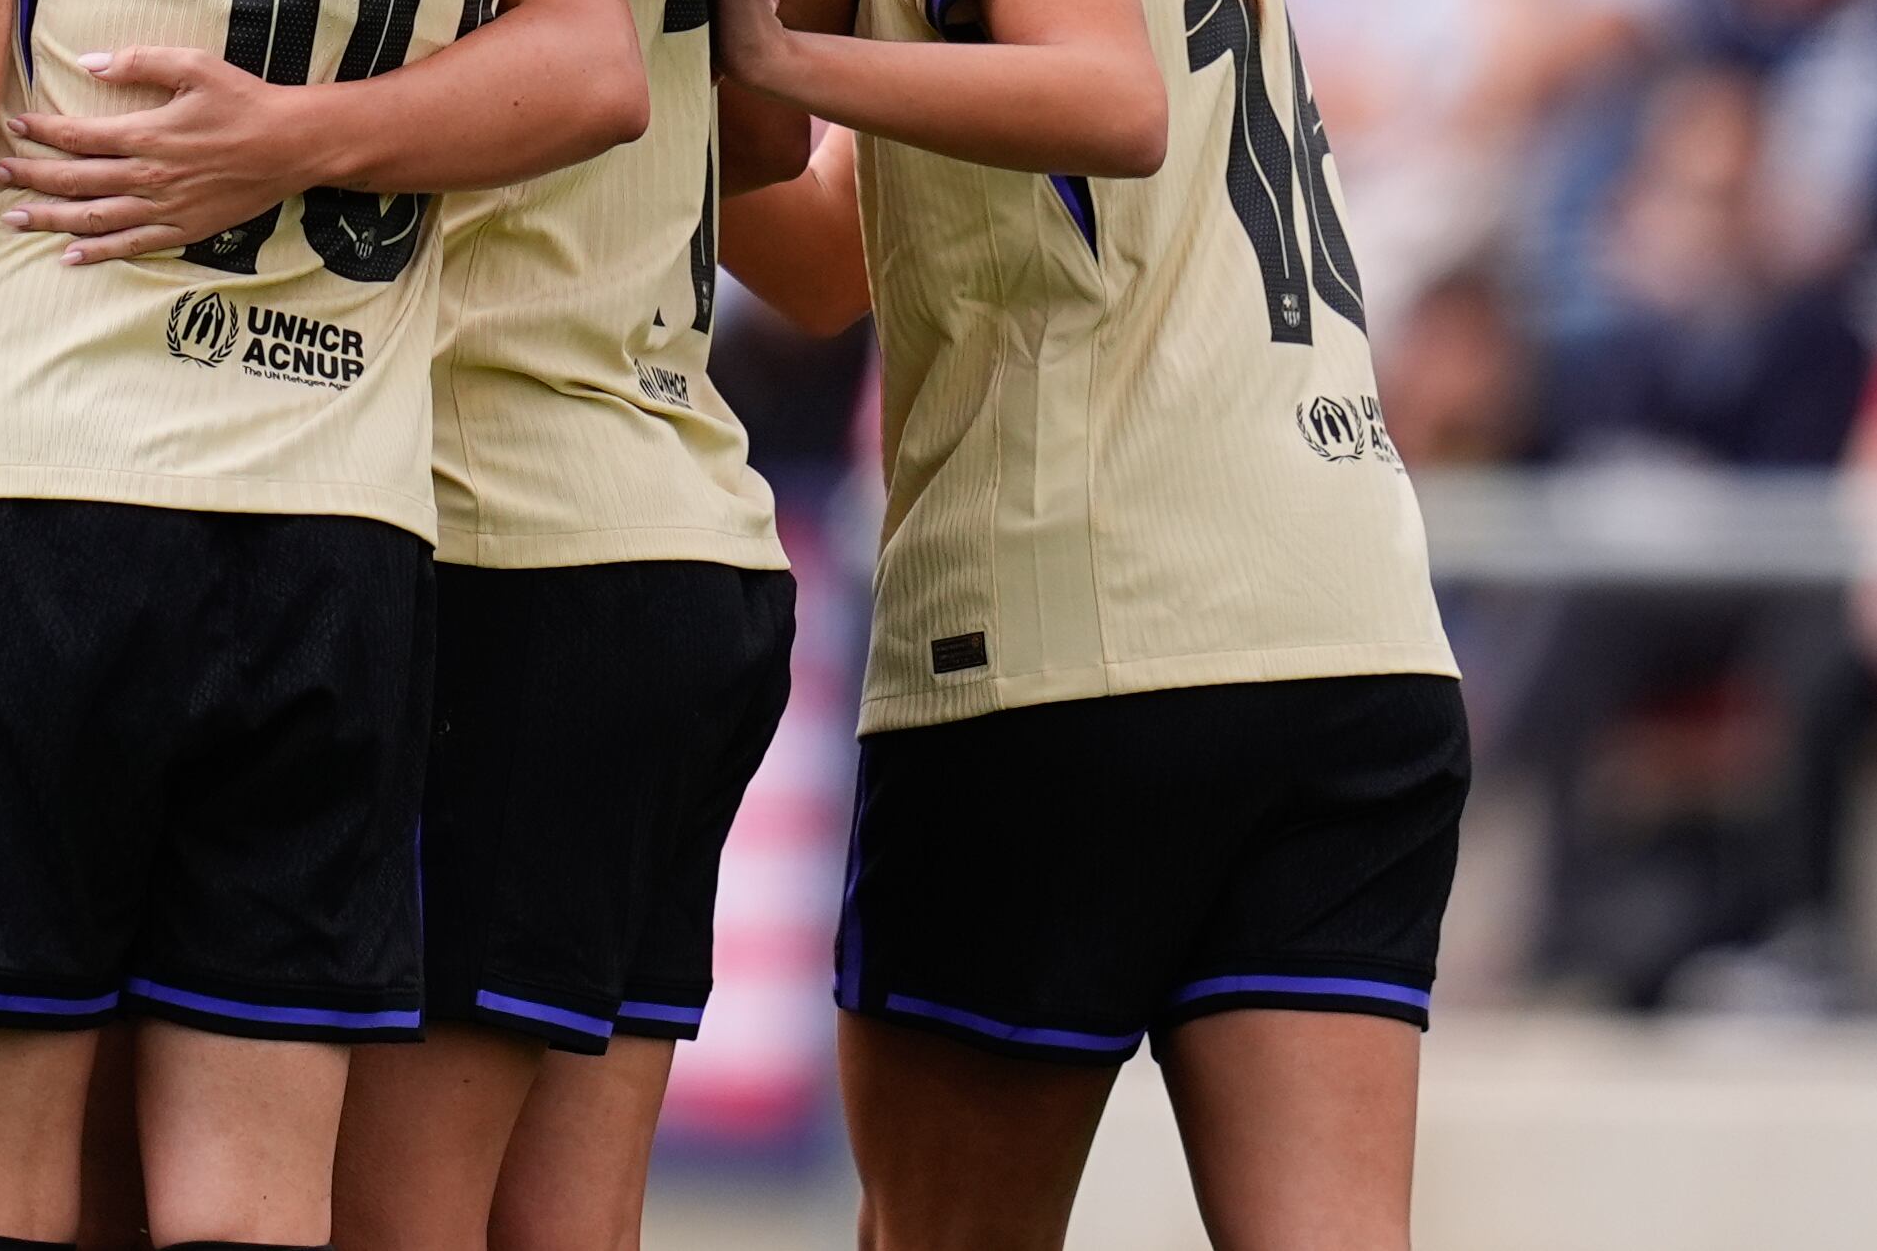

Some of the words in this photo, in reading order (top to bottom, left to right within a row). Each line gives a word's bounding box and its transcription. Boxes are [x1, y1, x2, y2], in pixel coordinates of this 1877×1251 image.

[248, 305, 364, 359] UNHCR
[242, 337, 364, 382] ACNUR
[243, 365, 262, 377] The
[264, 369, 281, 380] UN
